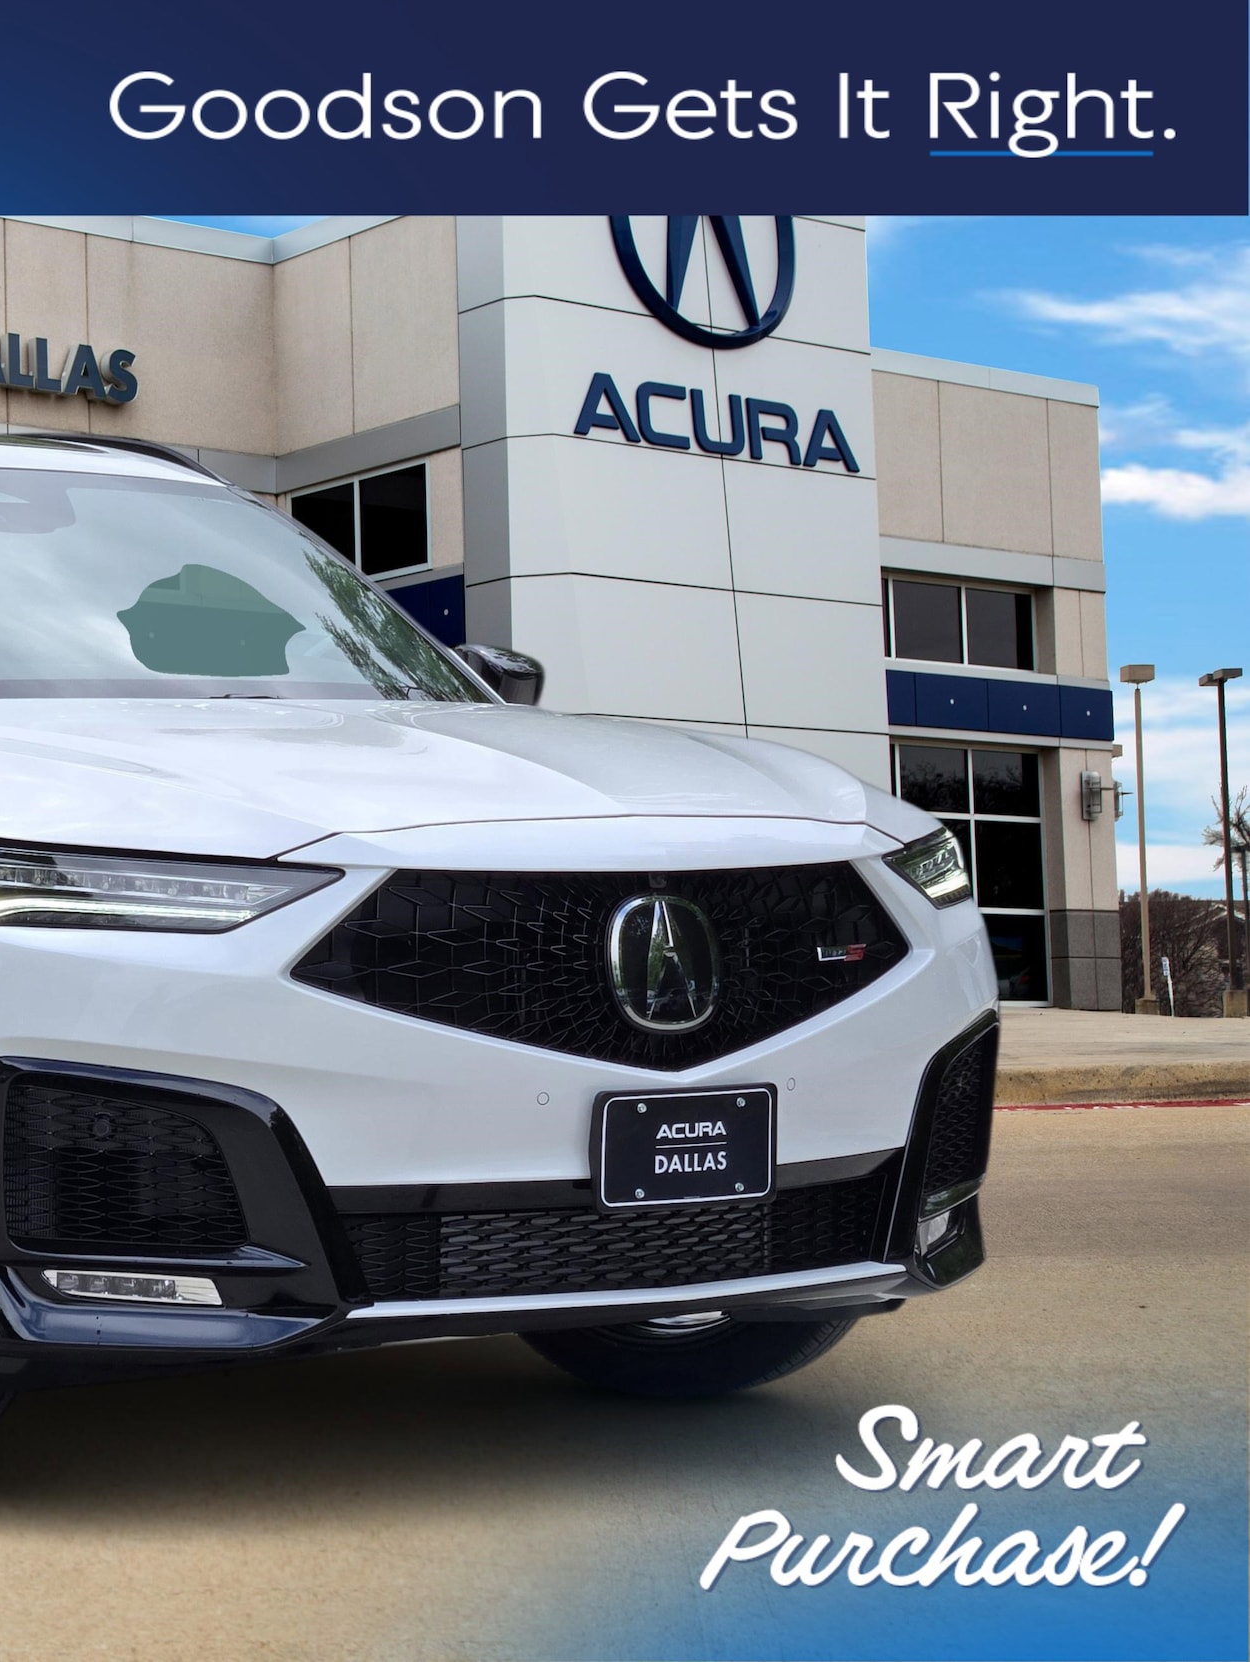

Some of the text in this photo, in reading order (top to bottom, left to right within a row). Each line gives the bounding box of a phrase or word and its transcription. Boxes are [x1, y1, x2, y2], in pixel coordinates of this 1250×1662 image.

[573, 372, 860, 474] ACURA
[655, 1120, 727, 1140] ACURA
[654, 1150, 727, 1174] DALLAS
